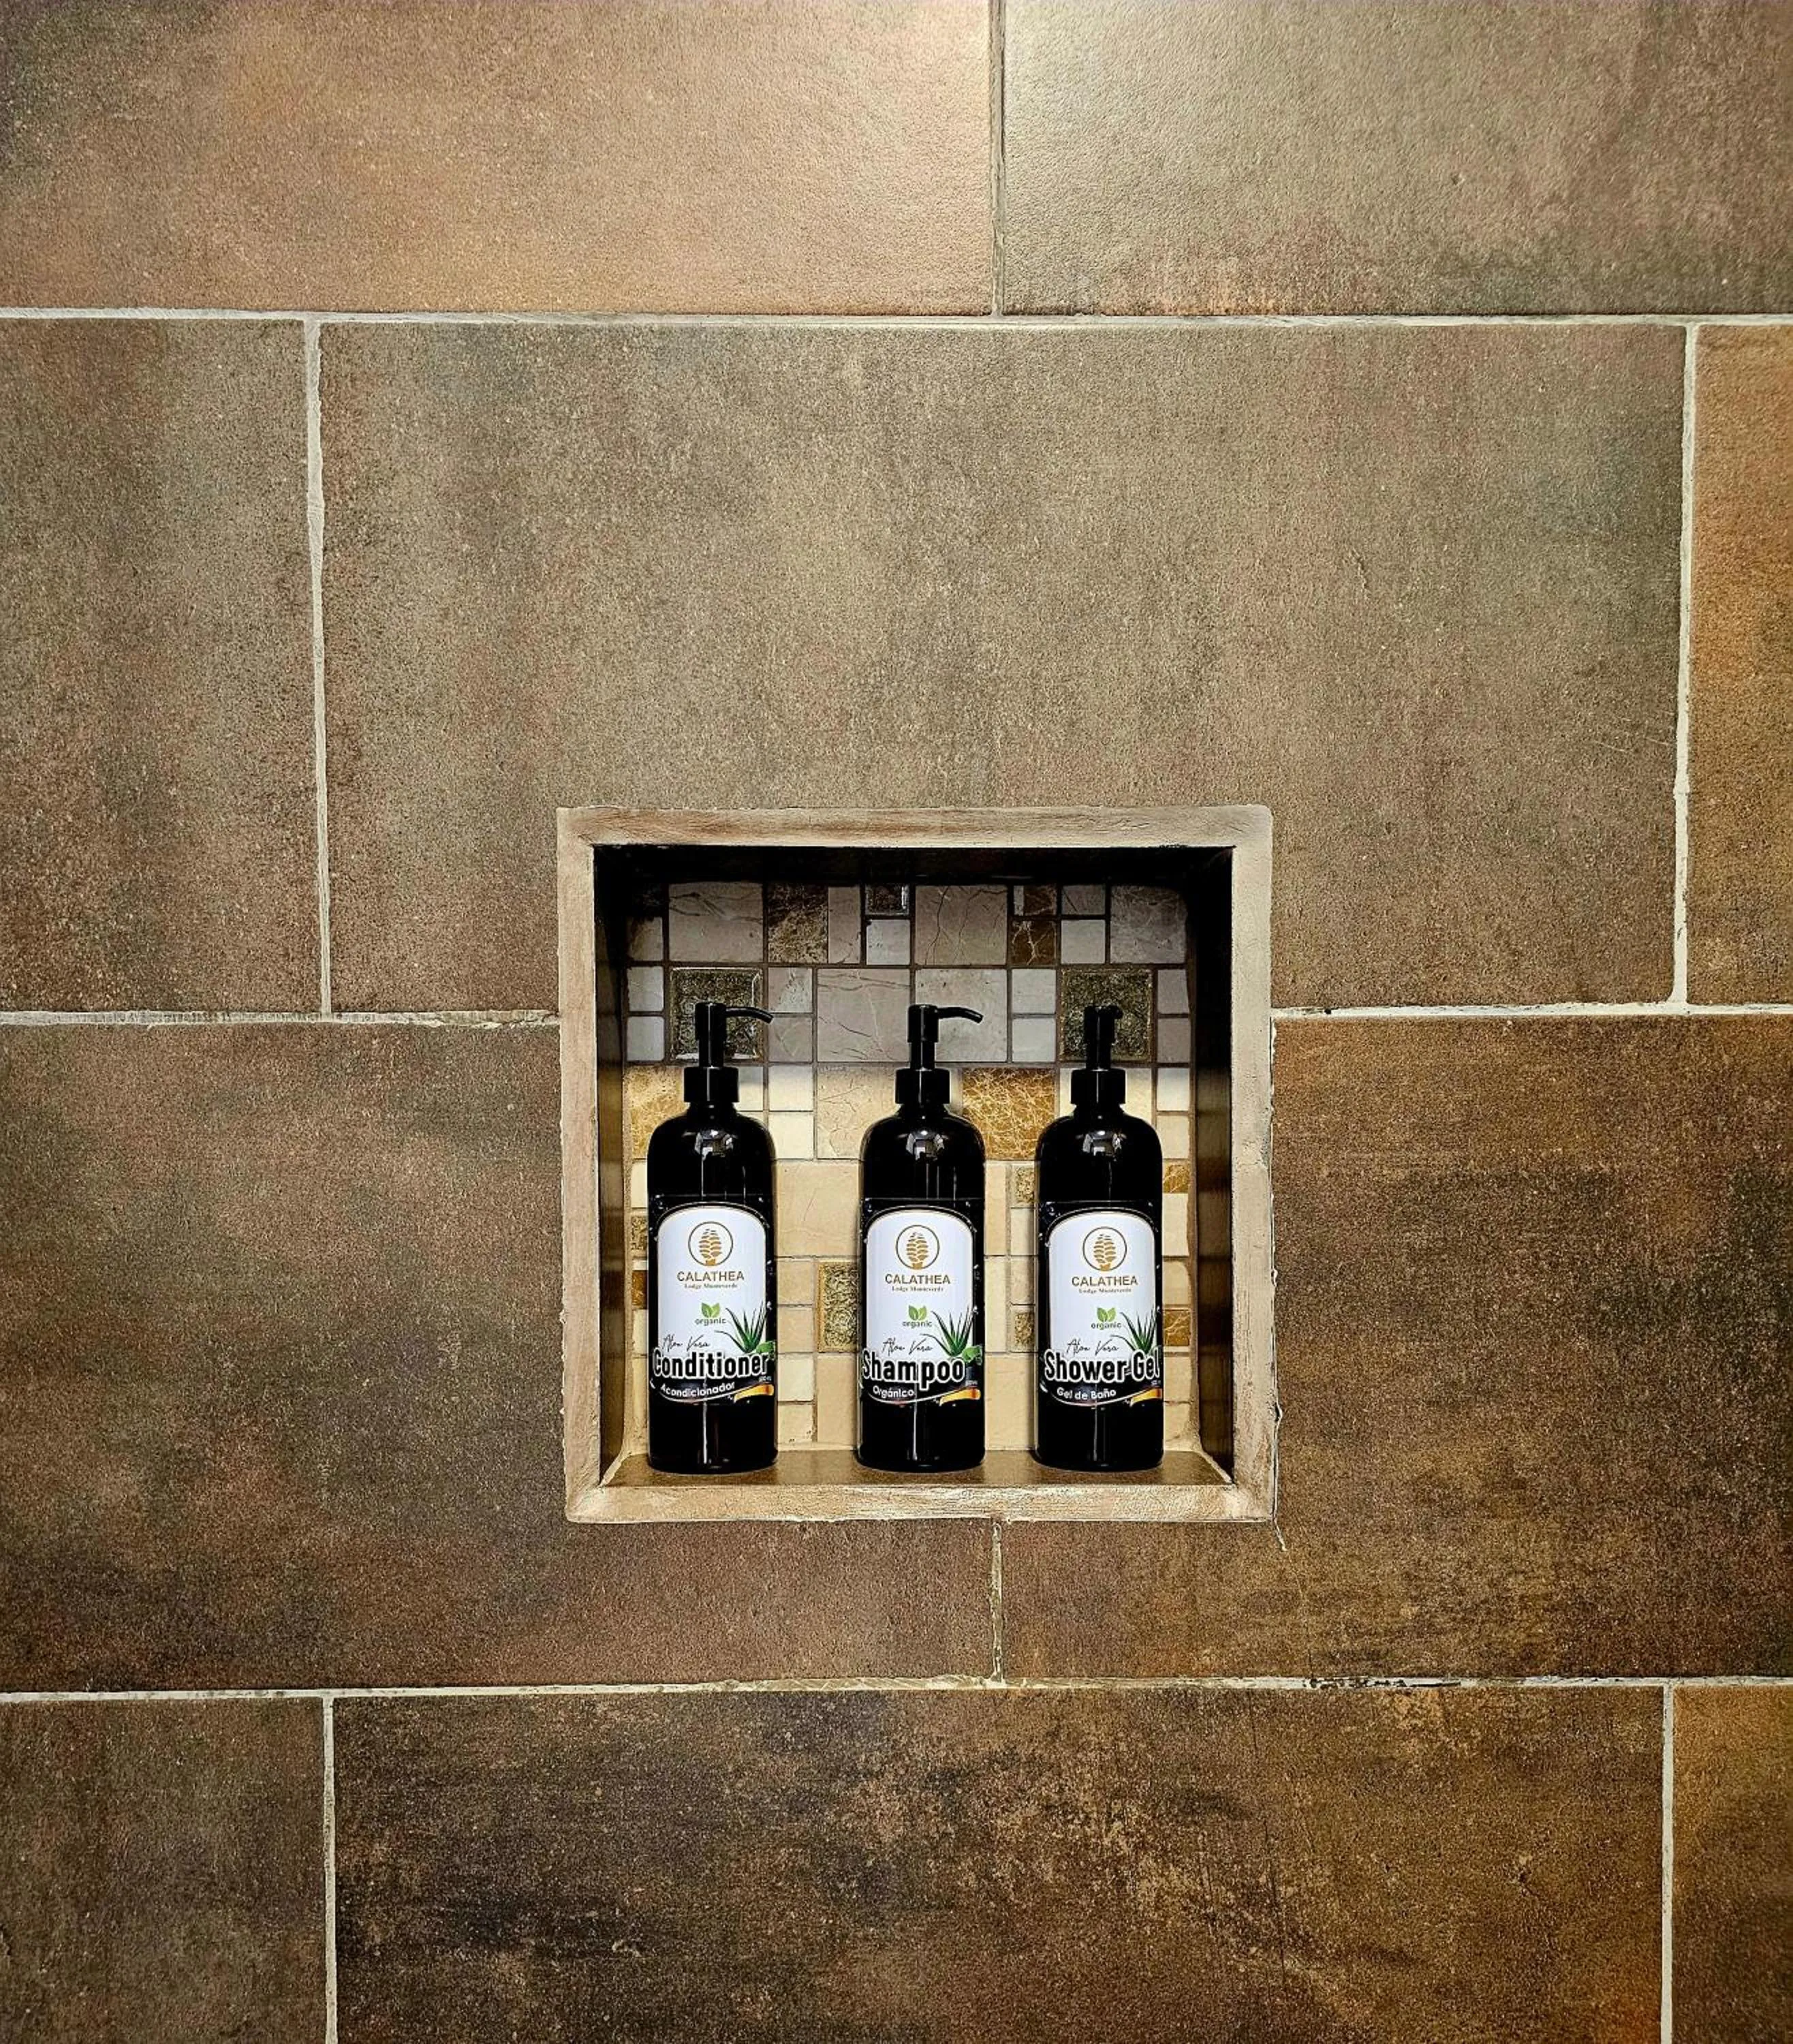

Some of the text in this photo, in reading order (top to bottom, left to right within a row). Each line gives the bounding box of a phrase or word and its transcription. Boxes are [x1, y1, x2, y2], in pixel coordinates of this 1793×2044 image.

[676, 1271, 745, 1282] CALATHEA
[885, 1273, 951, 1284] CALATHEA
[1072, 1275, 1138, 1286] CALATHEA
[694, 1317, 727, 1326] organic
[902, 1320, 933, 1329] organic
[1091, 1321, 1122, 1330] organic
[686, 1335, 711, 1351] Vera
[882, 1337, 934, 1356] Aloe Vera
[1066, 1337, 1119, 1356] Aloe Vera
[653, 1347, 770, 1380] Conditioner
[862, 1348, 966, 1391] Shampoo
[1044, 1348, 1160, 1383] Shower Gel
[660, 1382, 735, 1397] Acondicionador
[873, 1385, 915, 1398] Orgánico
[1057, 1387, 1117, 1400] Gel de Baño
